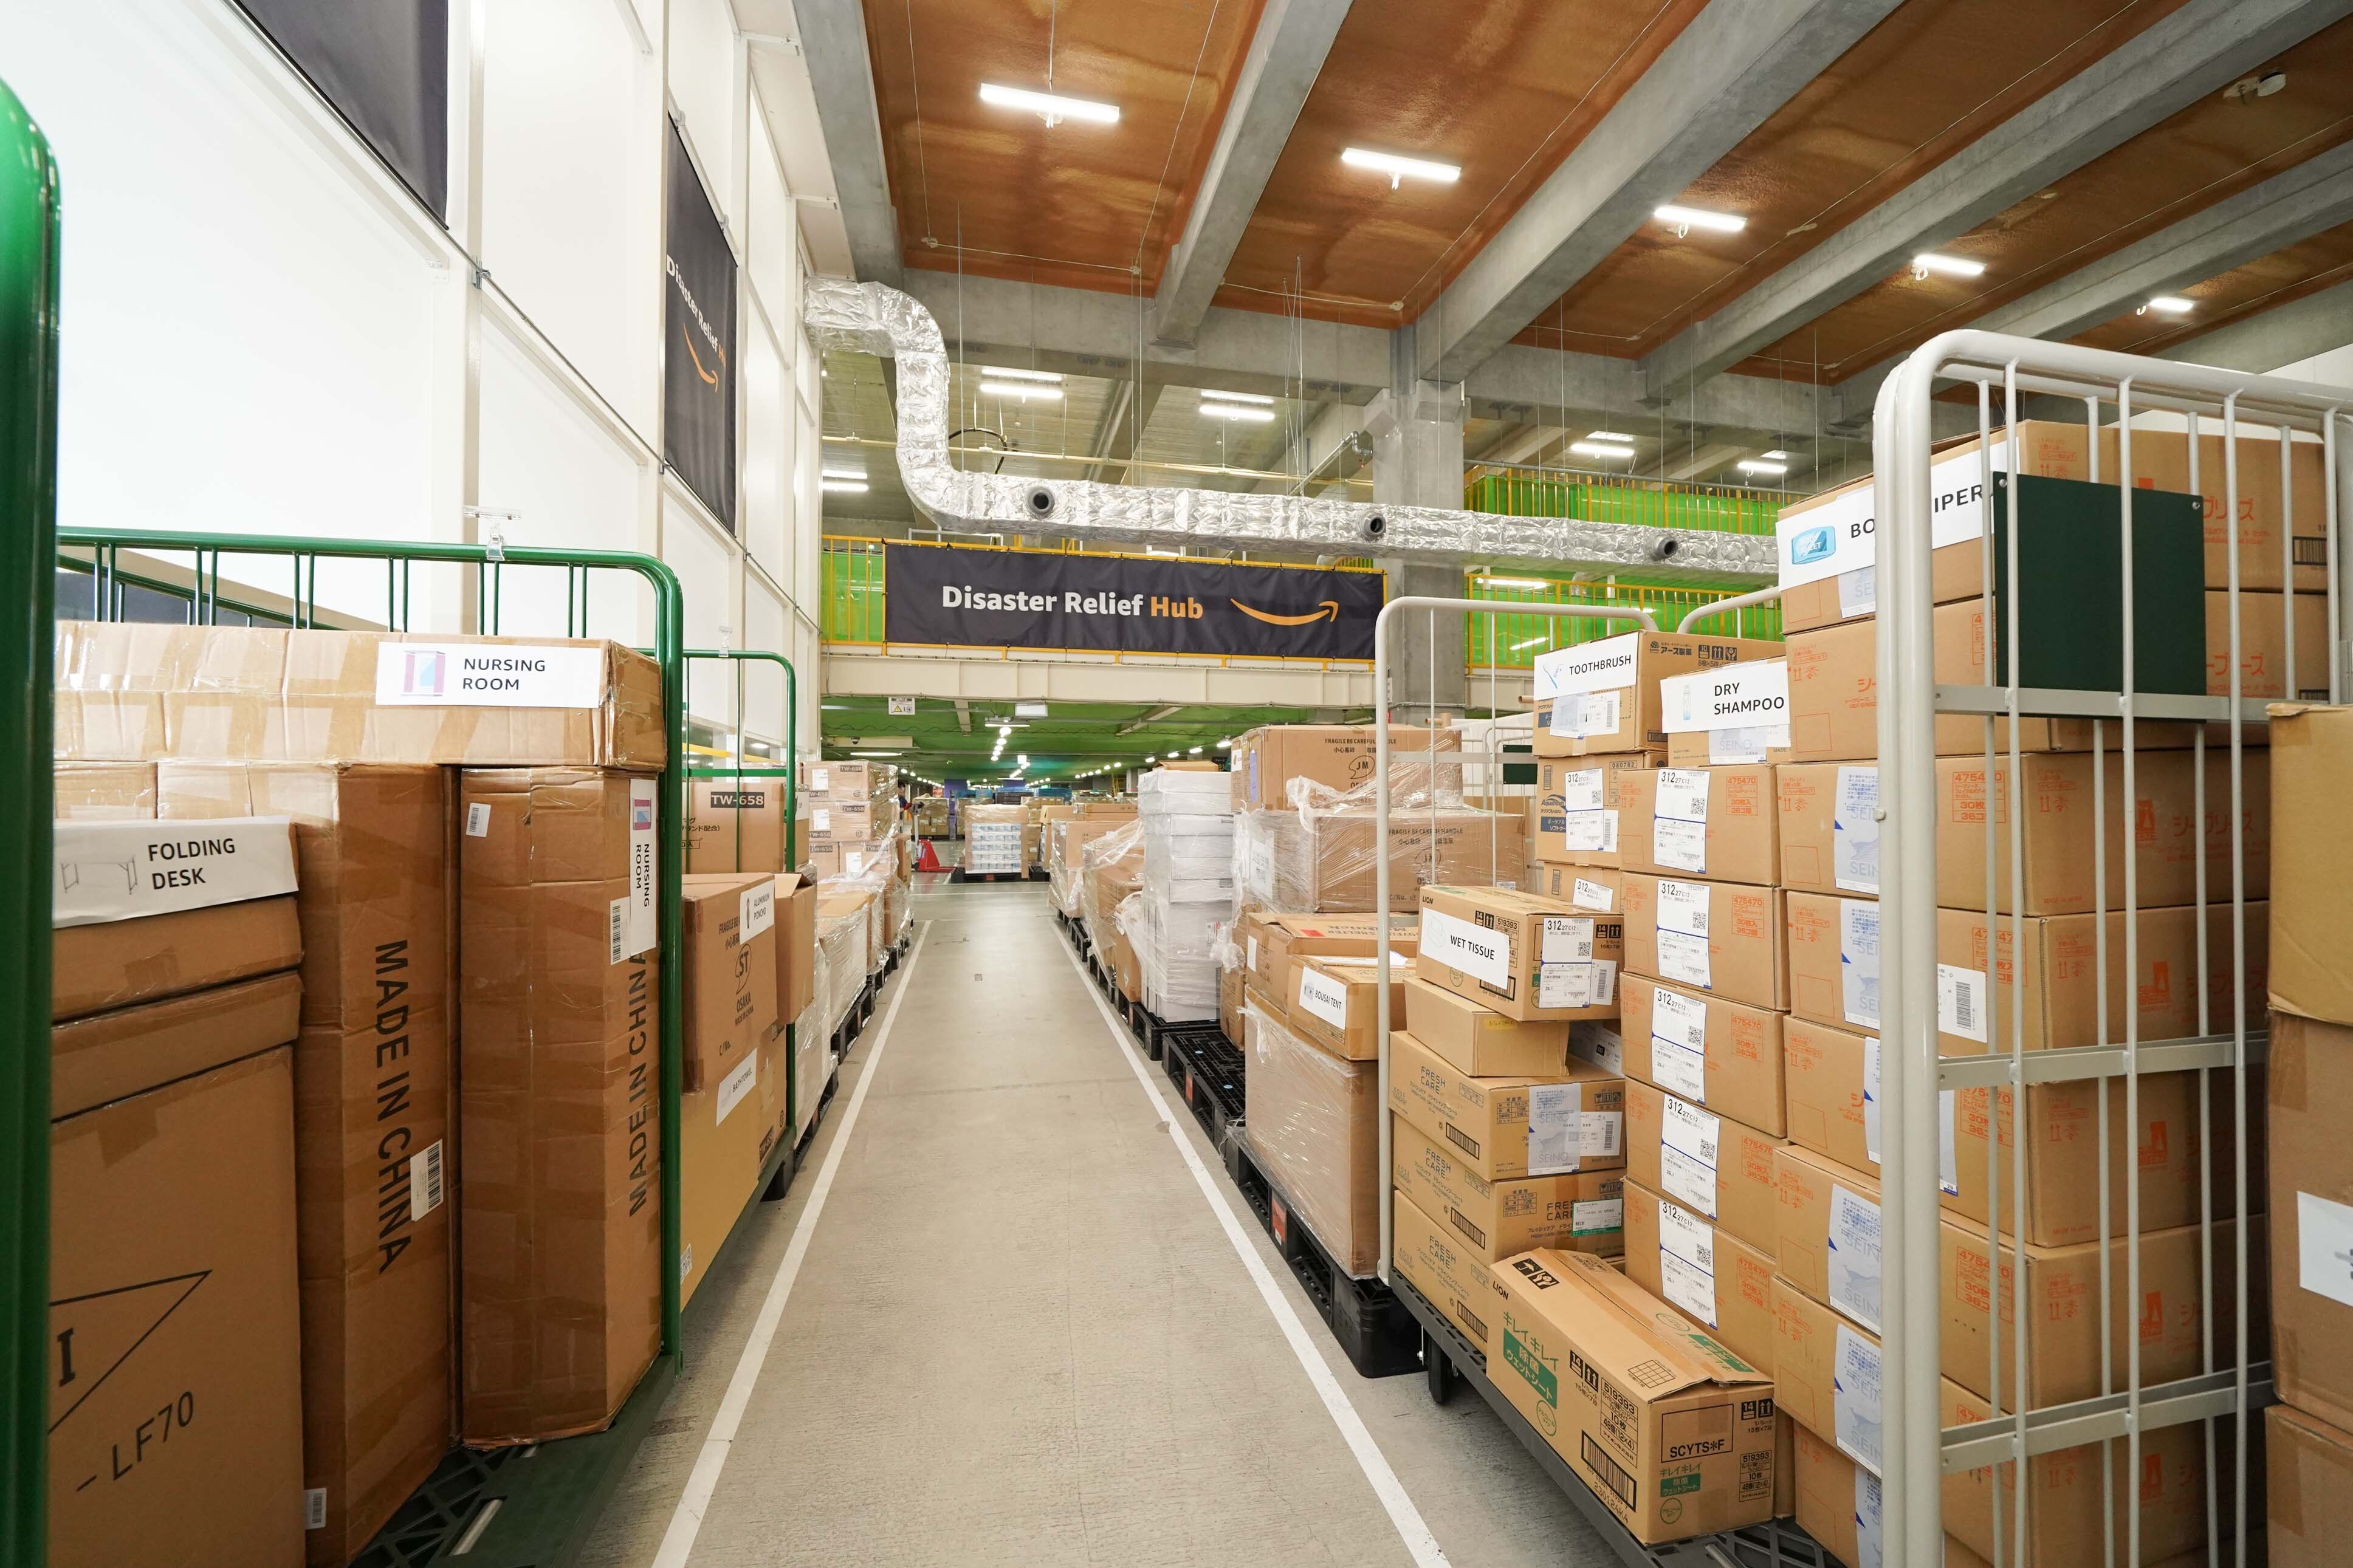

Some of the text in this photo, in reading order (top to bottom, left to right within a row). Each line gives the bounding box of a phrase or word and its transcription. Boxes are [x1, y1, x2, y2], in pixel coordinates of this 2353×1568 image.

[667, 255, 718, 353] Disaster Relief
[1850, 518, 1875, 539] BO
[943, 585, 1203, 619] Disaster Relief Hub
[464, 658, 545, 672] NURSING
[1569, 654, 1632, 676] TOOTHBRUSH
[463, 677, 520, 691] ROOM
[1714, 682, 1740, 696] DRY
[1714, 696, 1784, 715] SHAMPOO
[1356, 761, 1369, 770] JM
[1568, 773, 1578, 782] 312
[1661, 771, 1675, 783] 312
[1954, 772, 2002, 781] 47540
[711, 795, 764, 806] TW-658
[1960, 801, 1986, 810] 30枚
[148, 838, 235, 861] FOLDING
[152, 868, 206, 890] DESK
[1577, 881, 1589, 892] 312
[1661, 883, 1675, 895] 312
[1422, 896, 1434, 905] LION
[1733, 897, 1763, 906] 475470
[754, 907, 766, 921] PONCHO
[1497, 918, 1517, 930] 519393
[1547, 920, 1561, 931] 312
[1450, 934, 1466, 949] WET
[1468, 941, 1495, 960] TISSUE
[738, 950, 749, 976] ST
[737, 991, 752, 1013] OSAKA
[1314, 990, 1342, 1011] BOUSAI TENT
[1657, 991, 1671, 1005] 312
[1733, 1016, 1761, 1031] 475470
[628, 1063, 647, 1104] IN
[1420, 1076, 1440, 1095] CARE
[1421, 1066, 1446, 1088] FRESH
[376, 940, 412, 1275] MADE IN CHINA
[1668, 1098, 1683, 1115] 312
[1743, 1137, 1773, 1155] 475470
[628, 1109, 647, 1218] MADE
[1426, 1148, 1451, 1173] FRESH
[1538, 1151, 1569, 1163] SEINO
[1426, 1158, 1446, 1179] CARE
[1663, 1202, 1677, 1219] 312
[1429, 1235, 1456, 1264] FRESH
[1429, 1245, 1450, 1270] CARE
[1959, 1250, 2010, 1278] 47540
[1493, 1281, 1509, 1301] LION
[1845, 1287, 1880, 1320] SEIN
[1519, 1346, 1540, 1374] 除菌
[1571, 1352, 1581, 1367] 14
[1506, 1349, 1553, 1399] ウェットシート
[1604, 1381, 1635, 1415] 519393
[1743, 1402, 1753, 1411] 14
[1610, 1411, 1627, 1433] 10枚
[1742, 1452, 1770, 1463] 519393
